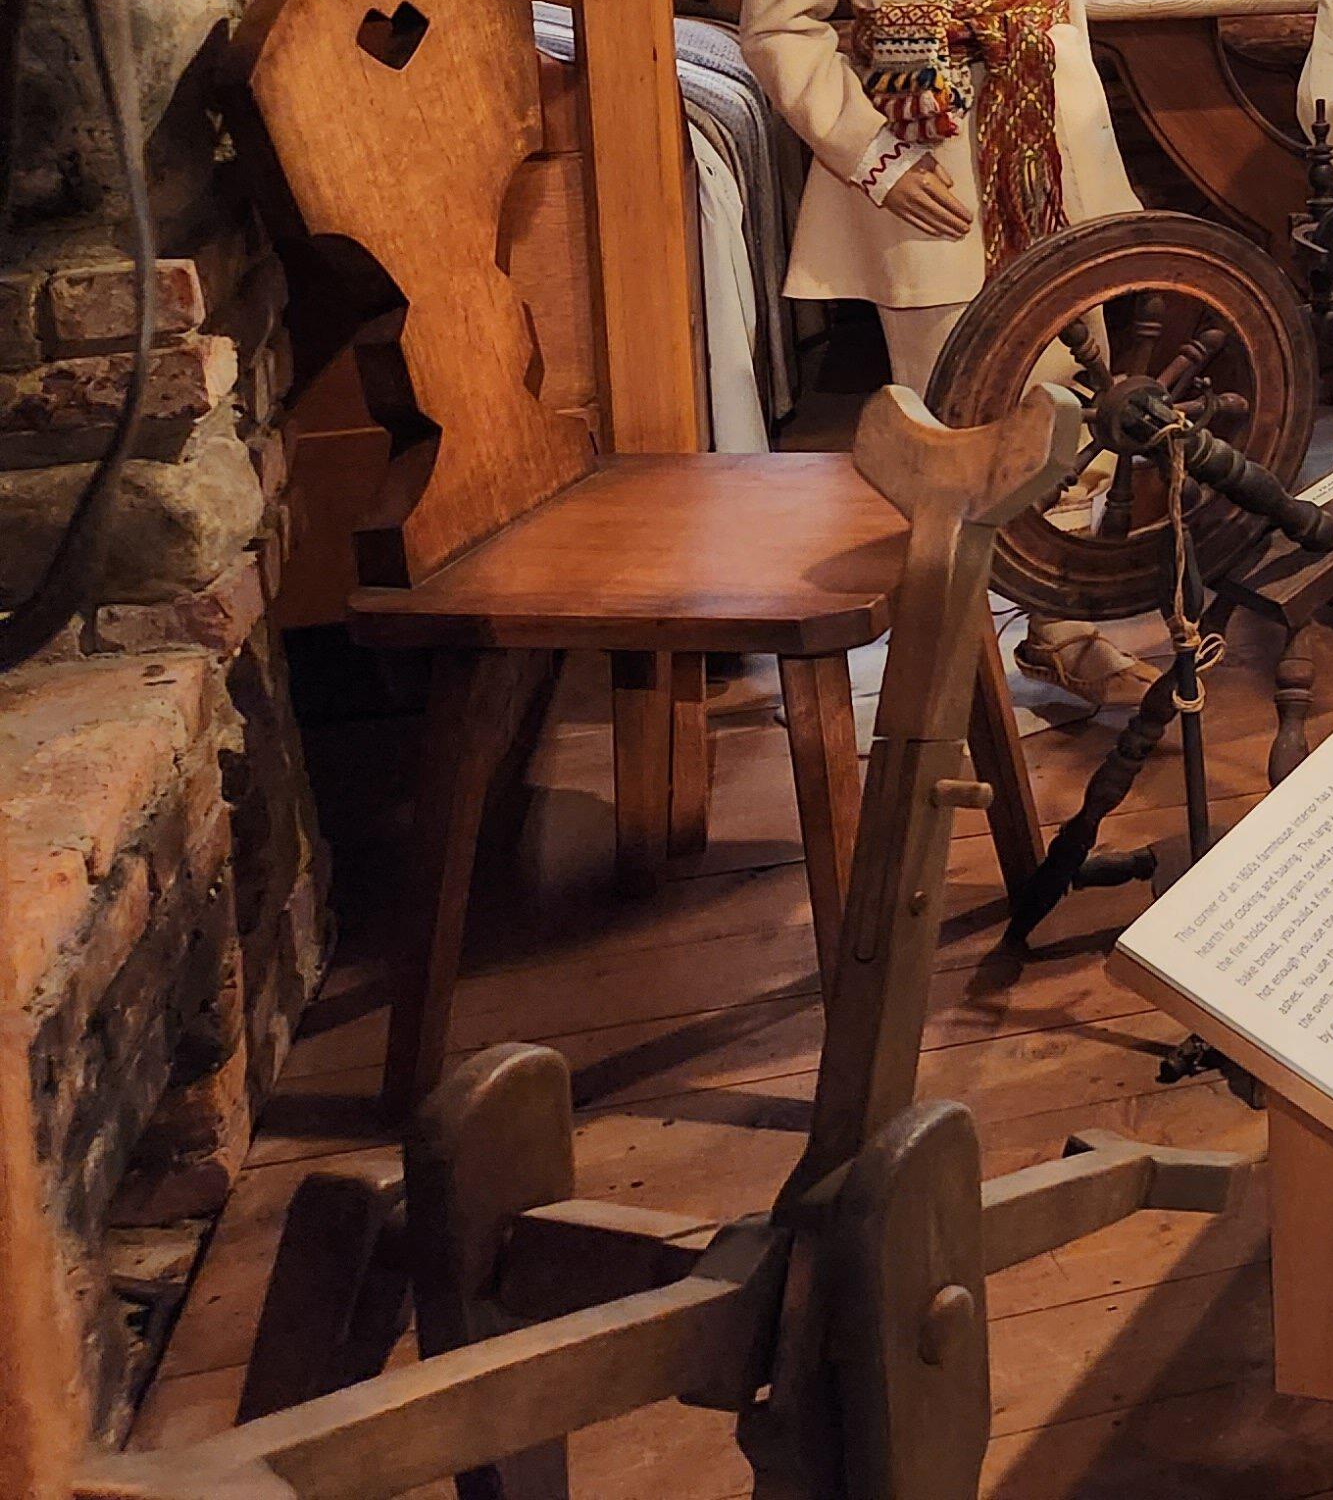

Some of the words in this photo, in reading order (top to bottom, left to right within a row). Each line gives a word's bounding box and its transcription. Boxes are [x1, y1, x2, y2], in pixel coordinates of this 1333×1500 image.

[1174, 926, 1195, 941] This
[1193, 901, 1218, 926] corner
[1256, 827, 1294, 861] farmhouse
[1292, 803, 1316, 827] interior
[1314, 791, 1330, 803] has
[1194, 931, 1223, 956] hearth
[1220, 918, 1234, 931] for
[1234, 891, 1266, 919] cooking
[1261, 875, 1277, 891] and
[1297, 838, 1315, 851] The
[1311, 820, 1332, 838] large
[1216, 956, 1233, 971] the
[1229, 941, 1247, 956] fire
[1244, 921, 1267, 941] holds
[1262, 897, 1289, 922] boiled
[1286, 879, 1306, 900] grain
[1310, 853, 1331, 871] feed
[1235, 966, 1258, 985] bake
[1280, 927, 1295, 943] you
[1291, 906, 1313, 926] build
[1314, 887, 1331, 900] fire
[1255, 984, 1274, 1000] hot
[1272, 957, 1298, 985] enough
[1297, 943, 1313, 958] you
[1311, 928, 1325, 942] use
[1301, 973, 1317, 986] You
[1315, 958, 1329, 973] use
[1298, 1013, 1315, 1028] the
